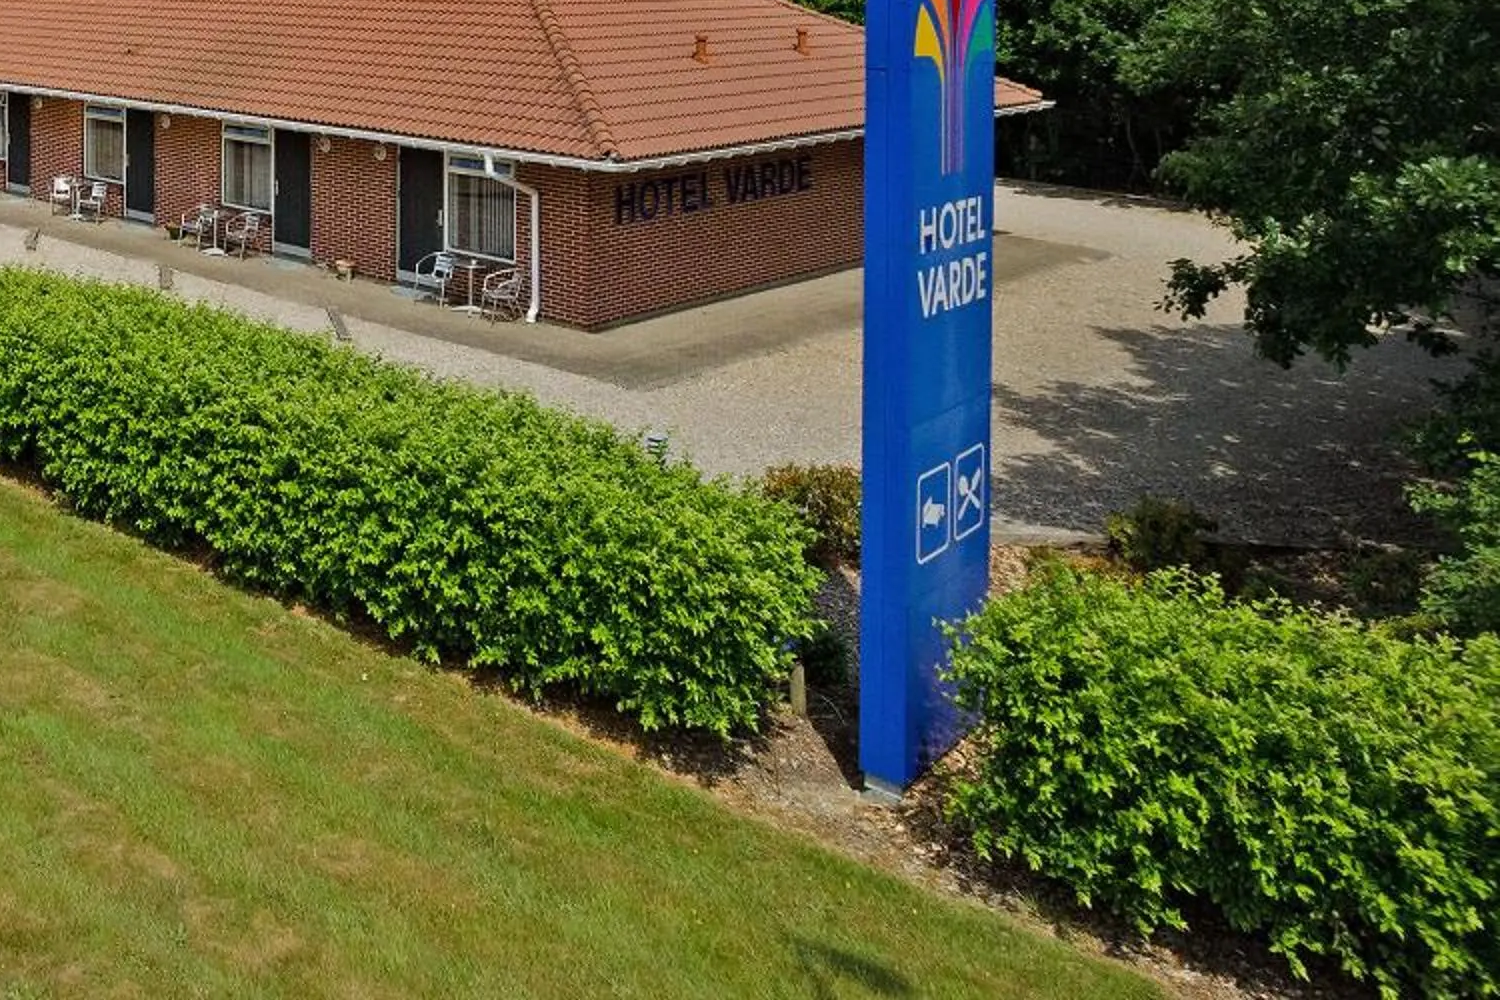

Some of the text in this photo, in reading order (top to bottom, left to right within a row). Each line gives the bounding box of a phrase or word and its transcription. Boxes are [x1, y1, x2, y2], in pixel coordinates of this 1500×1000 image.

[615, 155, 811, 225] HOTEL VARDE
[919, 195, 986, 255] HOTEL
[917, 251, 987, 318] VARDE
